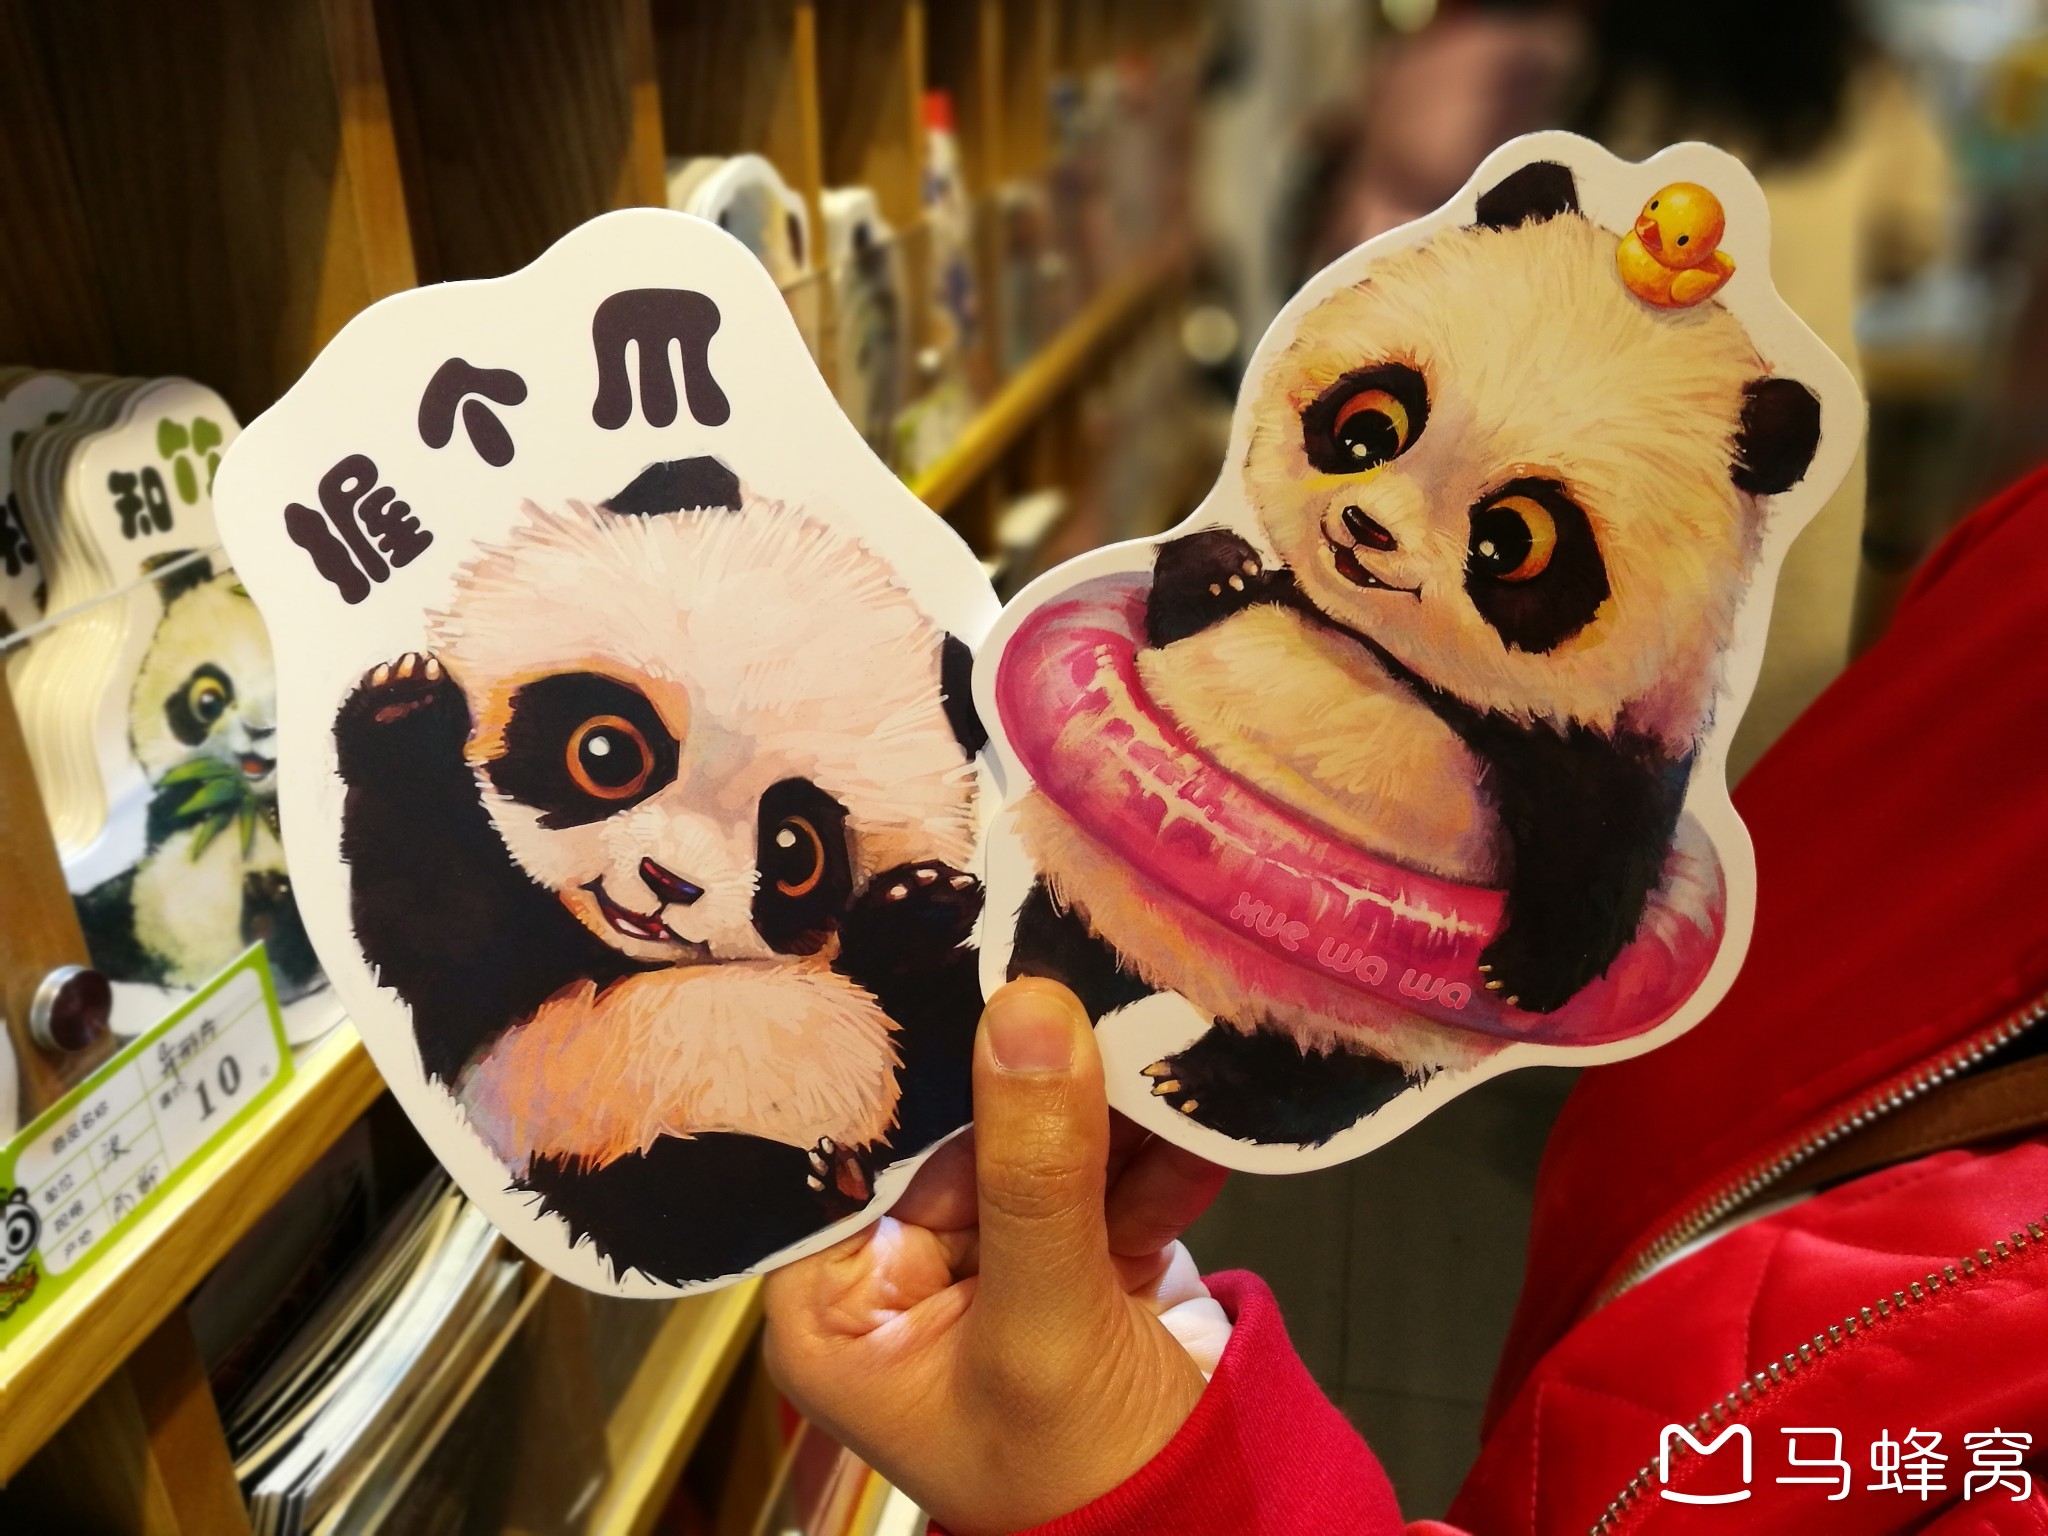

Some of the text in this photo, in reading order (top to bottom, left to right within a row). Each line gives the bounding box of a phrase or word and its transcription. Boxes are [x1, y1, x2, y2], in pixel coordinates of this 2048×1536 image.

[284, 288, 731, 605] 握个爪
[1317, 936, 1388, 986] wa
[1398, 968, 1472, 1010] wa
[195, 1054, 241, 1121] 10
